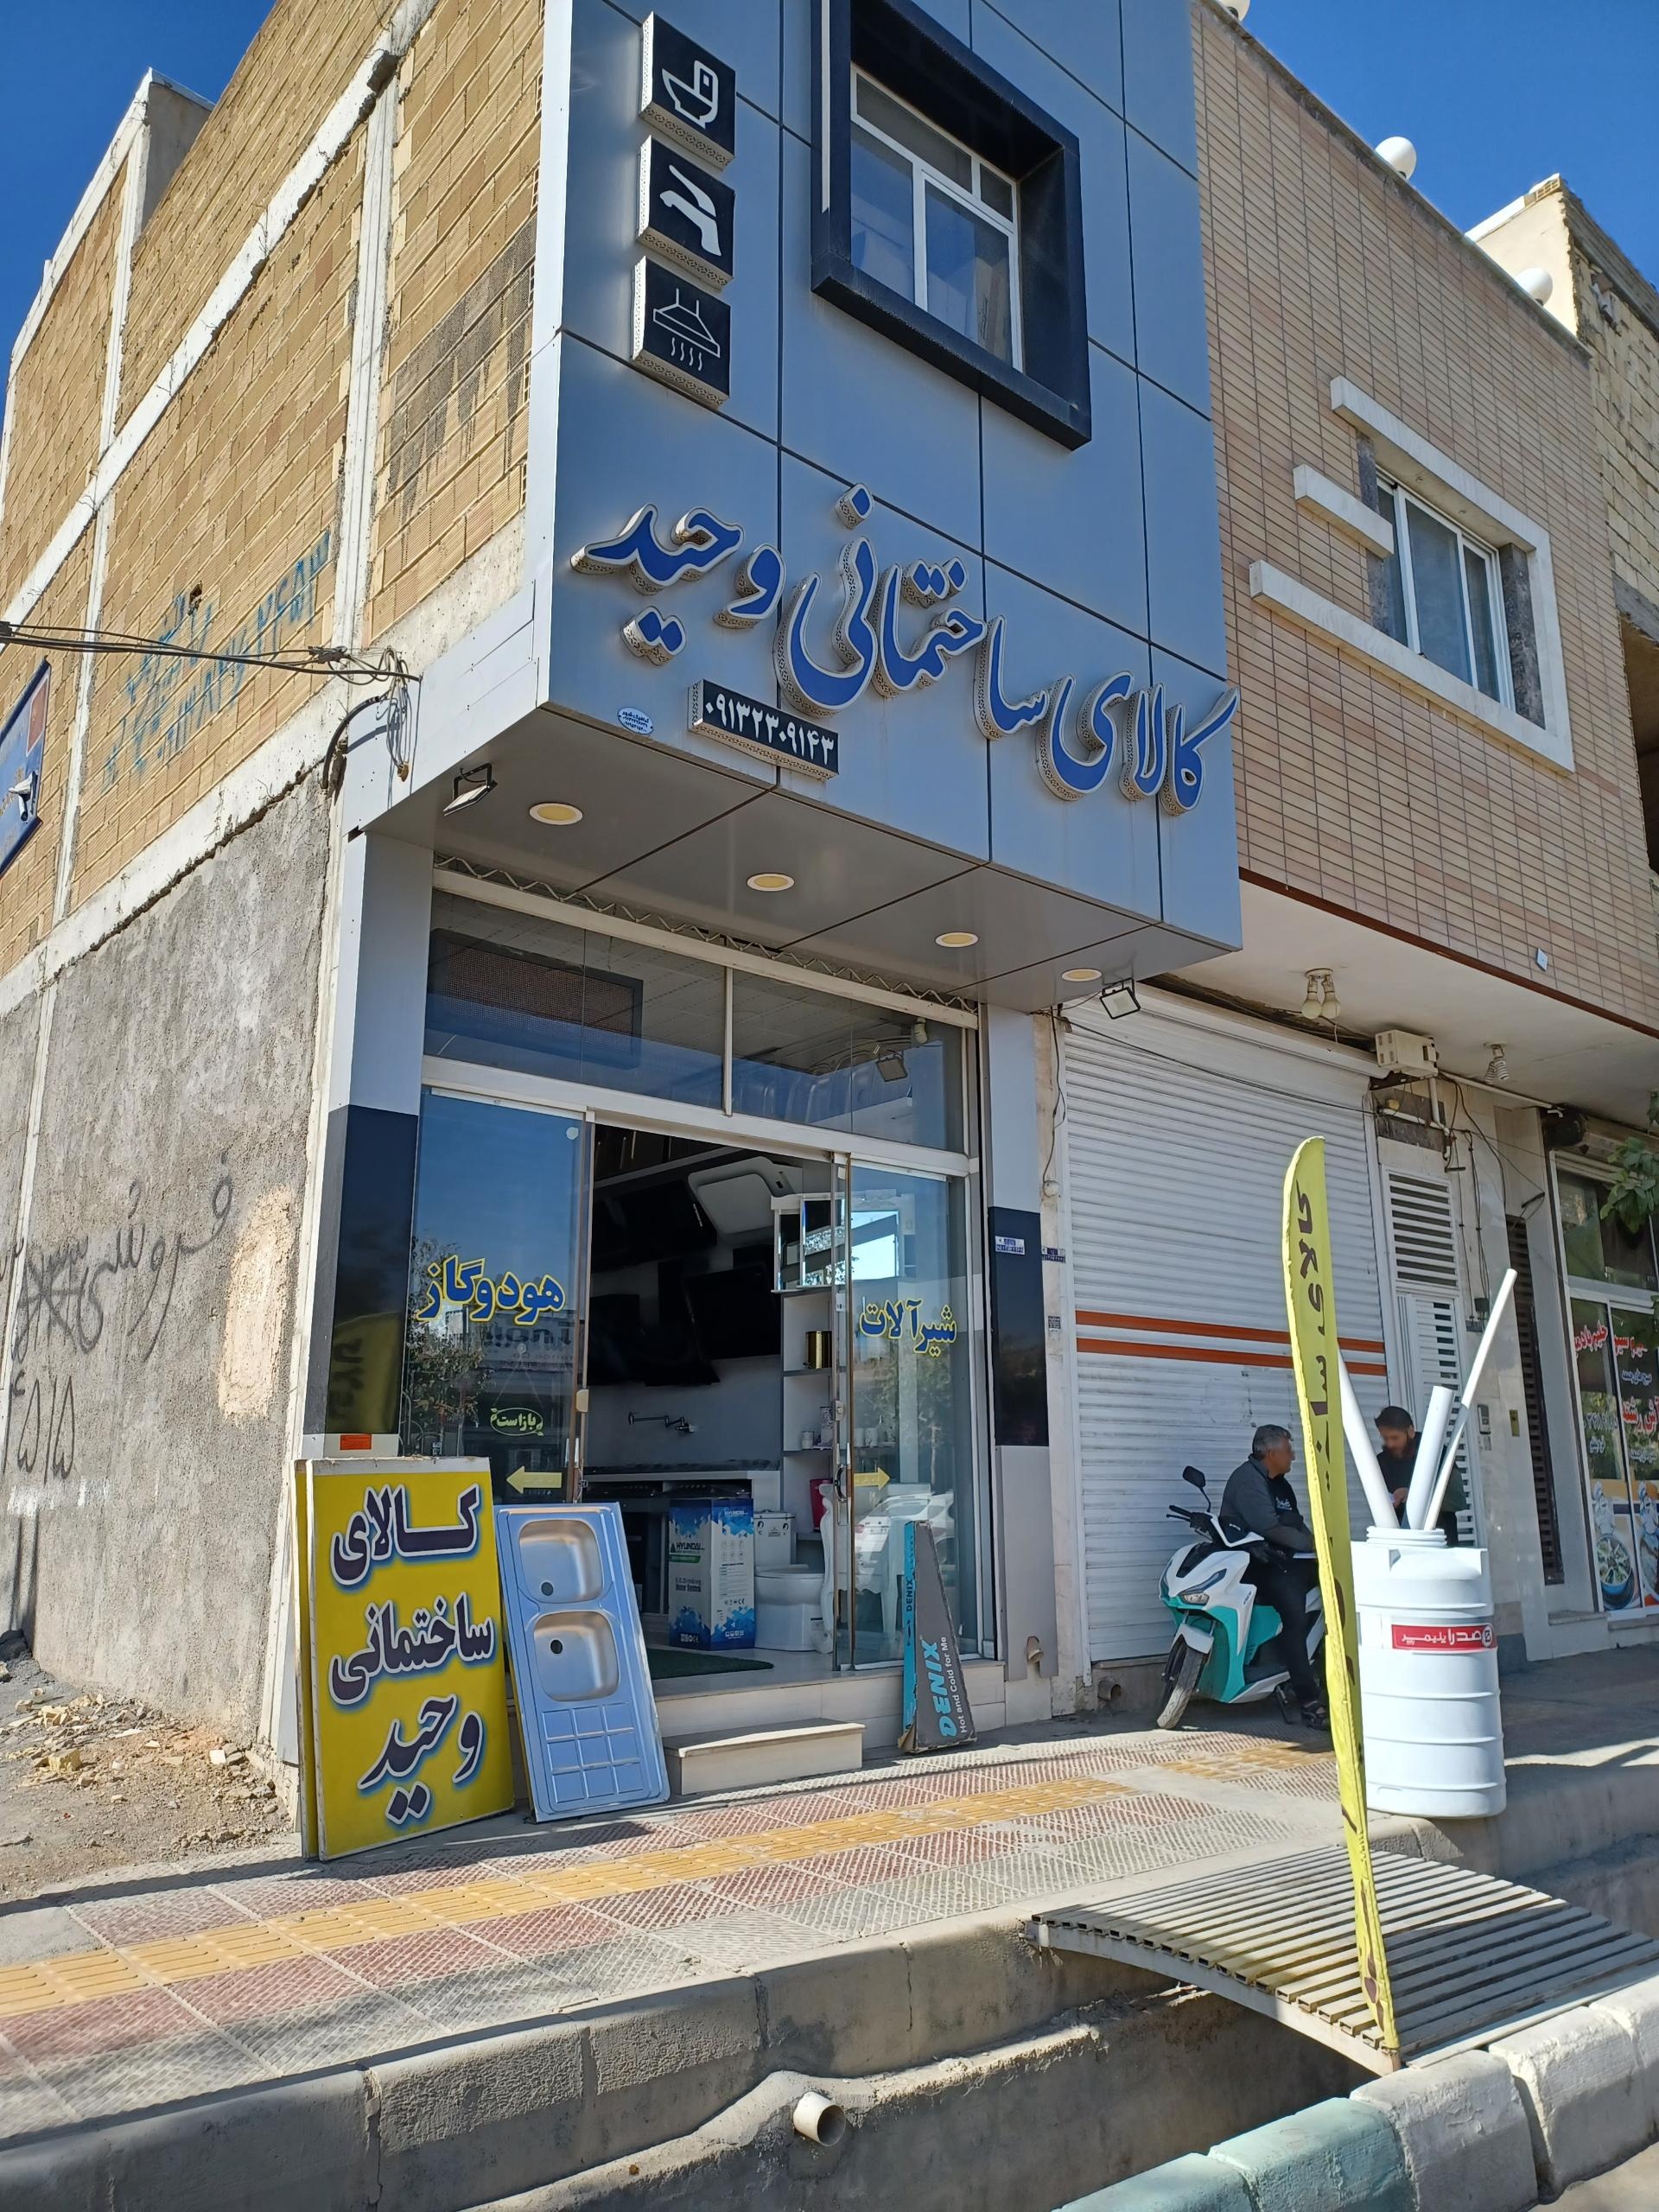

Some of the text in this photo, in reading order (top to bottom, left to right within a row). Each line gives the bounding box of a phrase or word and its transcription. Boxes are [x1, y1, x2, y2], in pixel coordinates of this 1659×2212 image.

[570, 483, 1241, 817] کالای ساختمانی وحید
[705, 693, 835, 766] ۰۹۱۳۲۳۰۹۱۴۳
[330, 1482, 481, 1586] کالای
[676, 1541, 702, 1551] HYUNDAI
[906, 1577, 915, 1612] DENIX
[329, 1592, 495, 1705] ساختمانی
[1448, 1628, 1482, 1645] صدرا
[921, 1639, 957, 1738] DENIX
[950, 1666, 959, 1694] Cold
[955, 1694, 965, 1713] and
[960, 1714, 969, 1734] Hot
[358, 1694, 484, 1825] وحید
